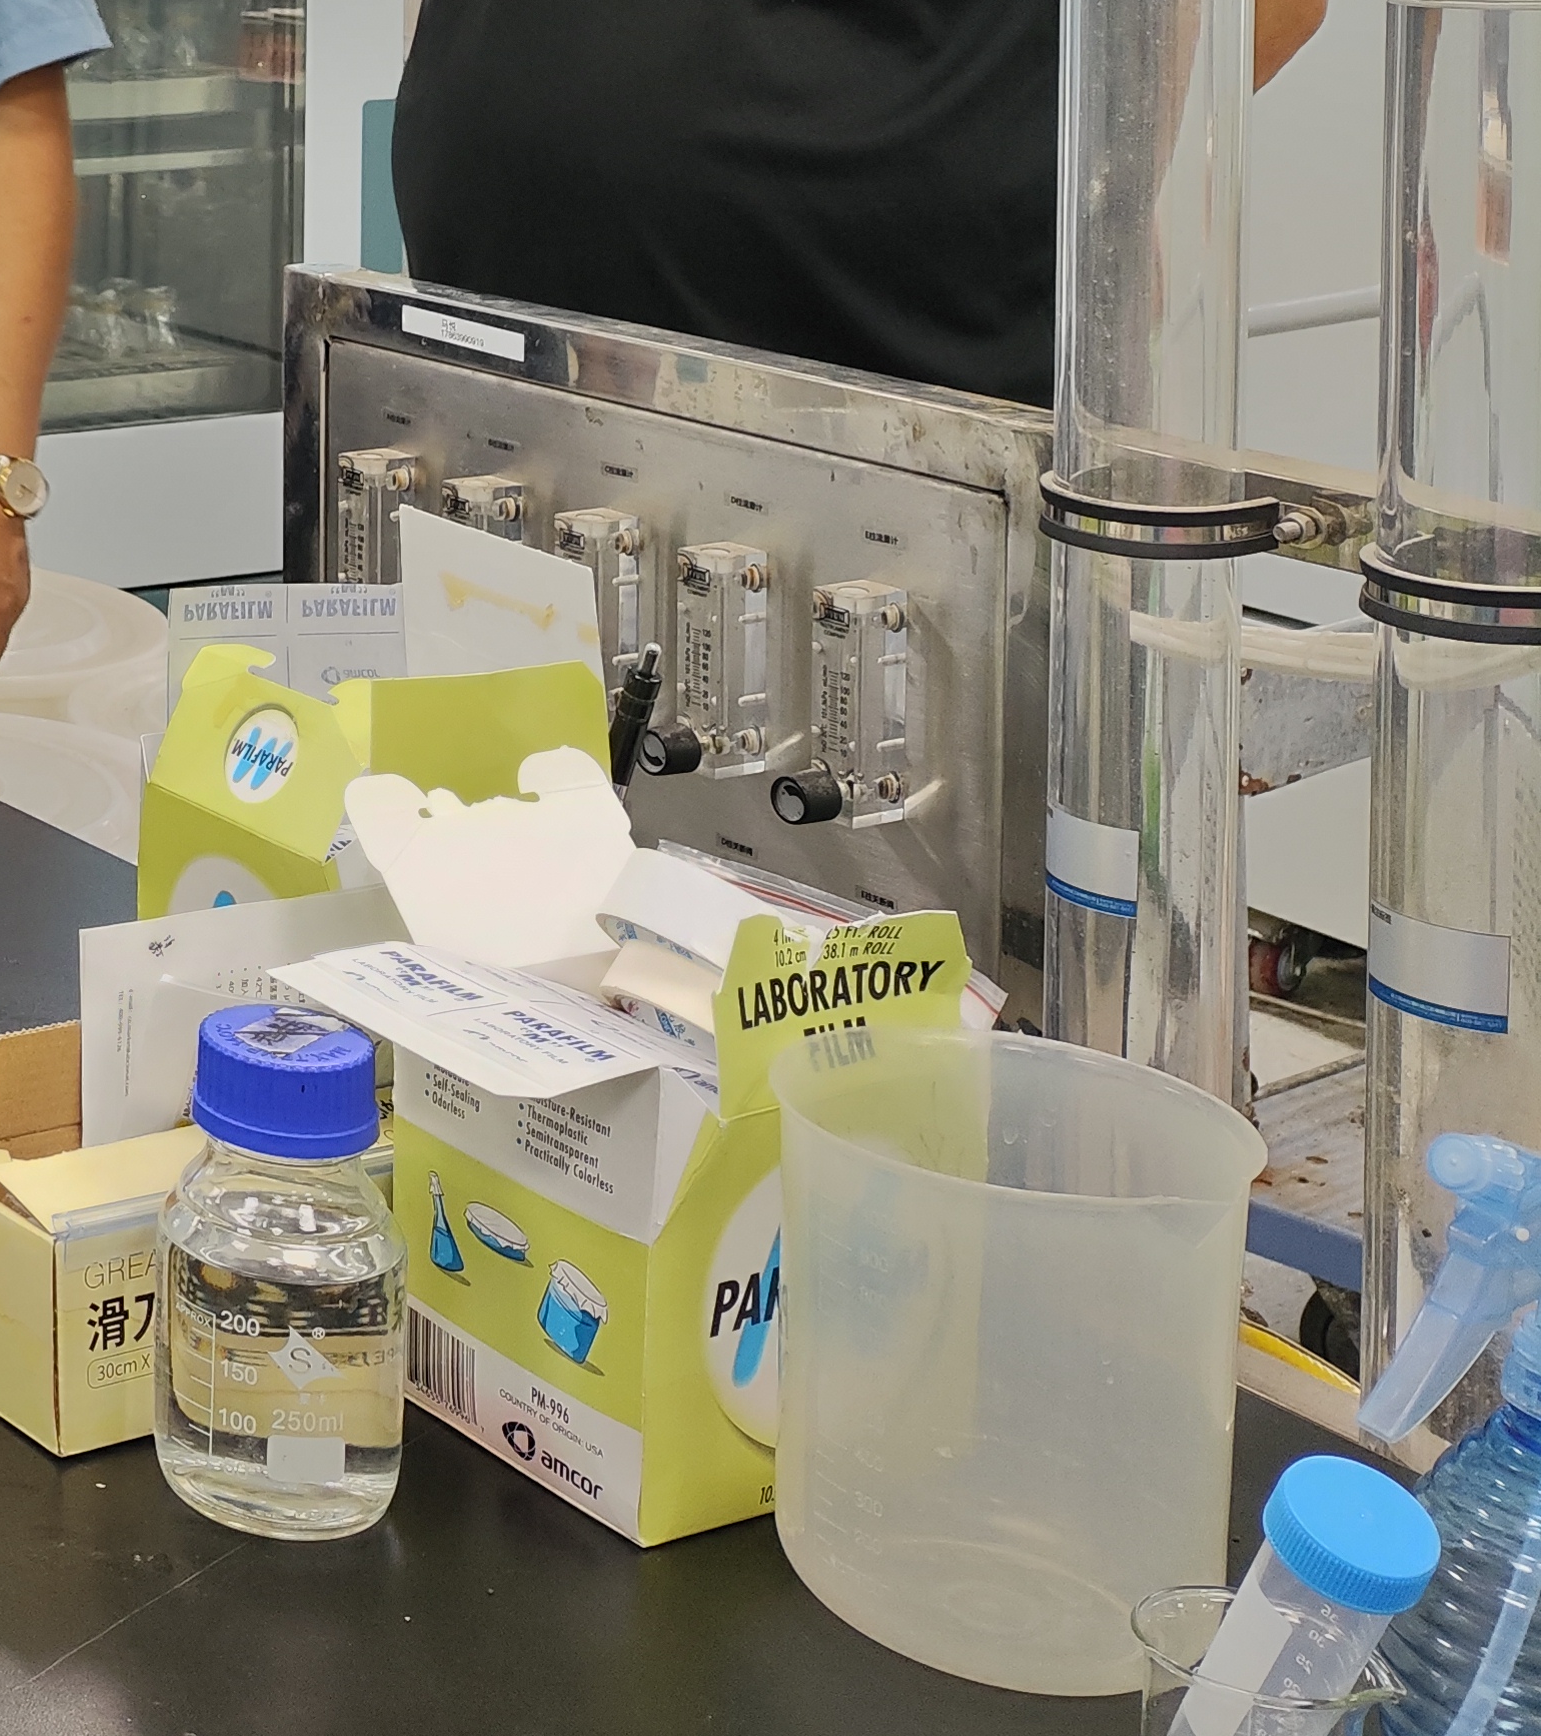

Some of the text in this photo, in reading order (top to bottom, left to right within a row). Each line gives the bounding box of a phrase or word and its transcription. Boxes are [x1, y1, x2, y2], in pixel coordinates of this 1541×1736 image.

[230, 738, 294, 778] PARAFILM
[868, 925, 904, 940] ROLL
[774, 950, 793, 968] 10.2
[823, 942, 846, 961] 38.1
[862, 941, 896, 956] ROLL
[379, 950, 484, 1002] PARAFILM
[738, 960, 946, 1031] LABORATORY
[501, 1009, 616, 1062] PARAFILM
[431, 1090, 466, 1120] Odorless
[432, 1073, 481, 1113] Self-Sealing
[526, 1103, 589, 1146] Thermoplastic
[529, 1097, 611, 1138] oisture-Resistant
[525, 1121, 600, 1169] Semitransparent
[524, 1138, 614, 1195] Practically Colorless
[220, 1310, 261, 1338] 200
[97, 1360, 138, 1382] 30cm
[221, 1360, 258, 1386] 150
[218, 1407, 257, 1434] 100
[271, 1409, 344, 1433] 250ml
[498, 1388, 605, 1459] COUNTRY OF ORIGIN: USA
[530, 1386, 570, 1424] PM-996
[540, 1449, 604, 1500] amcor
